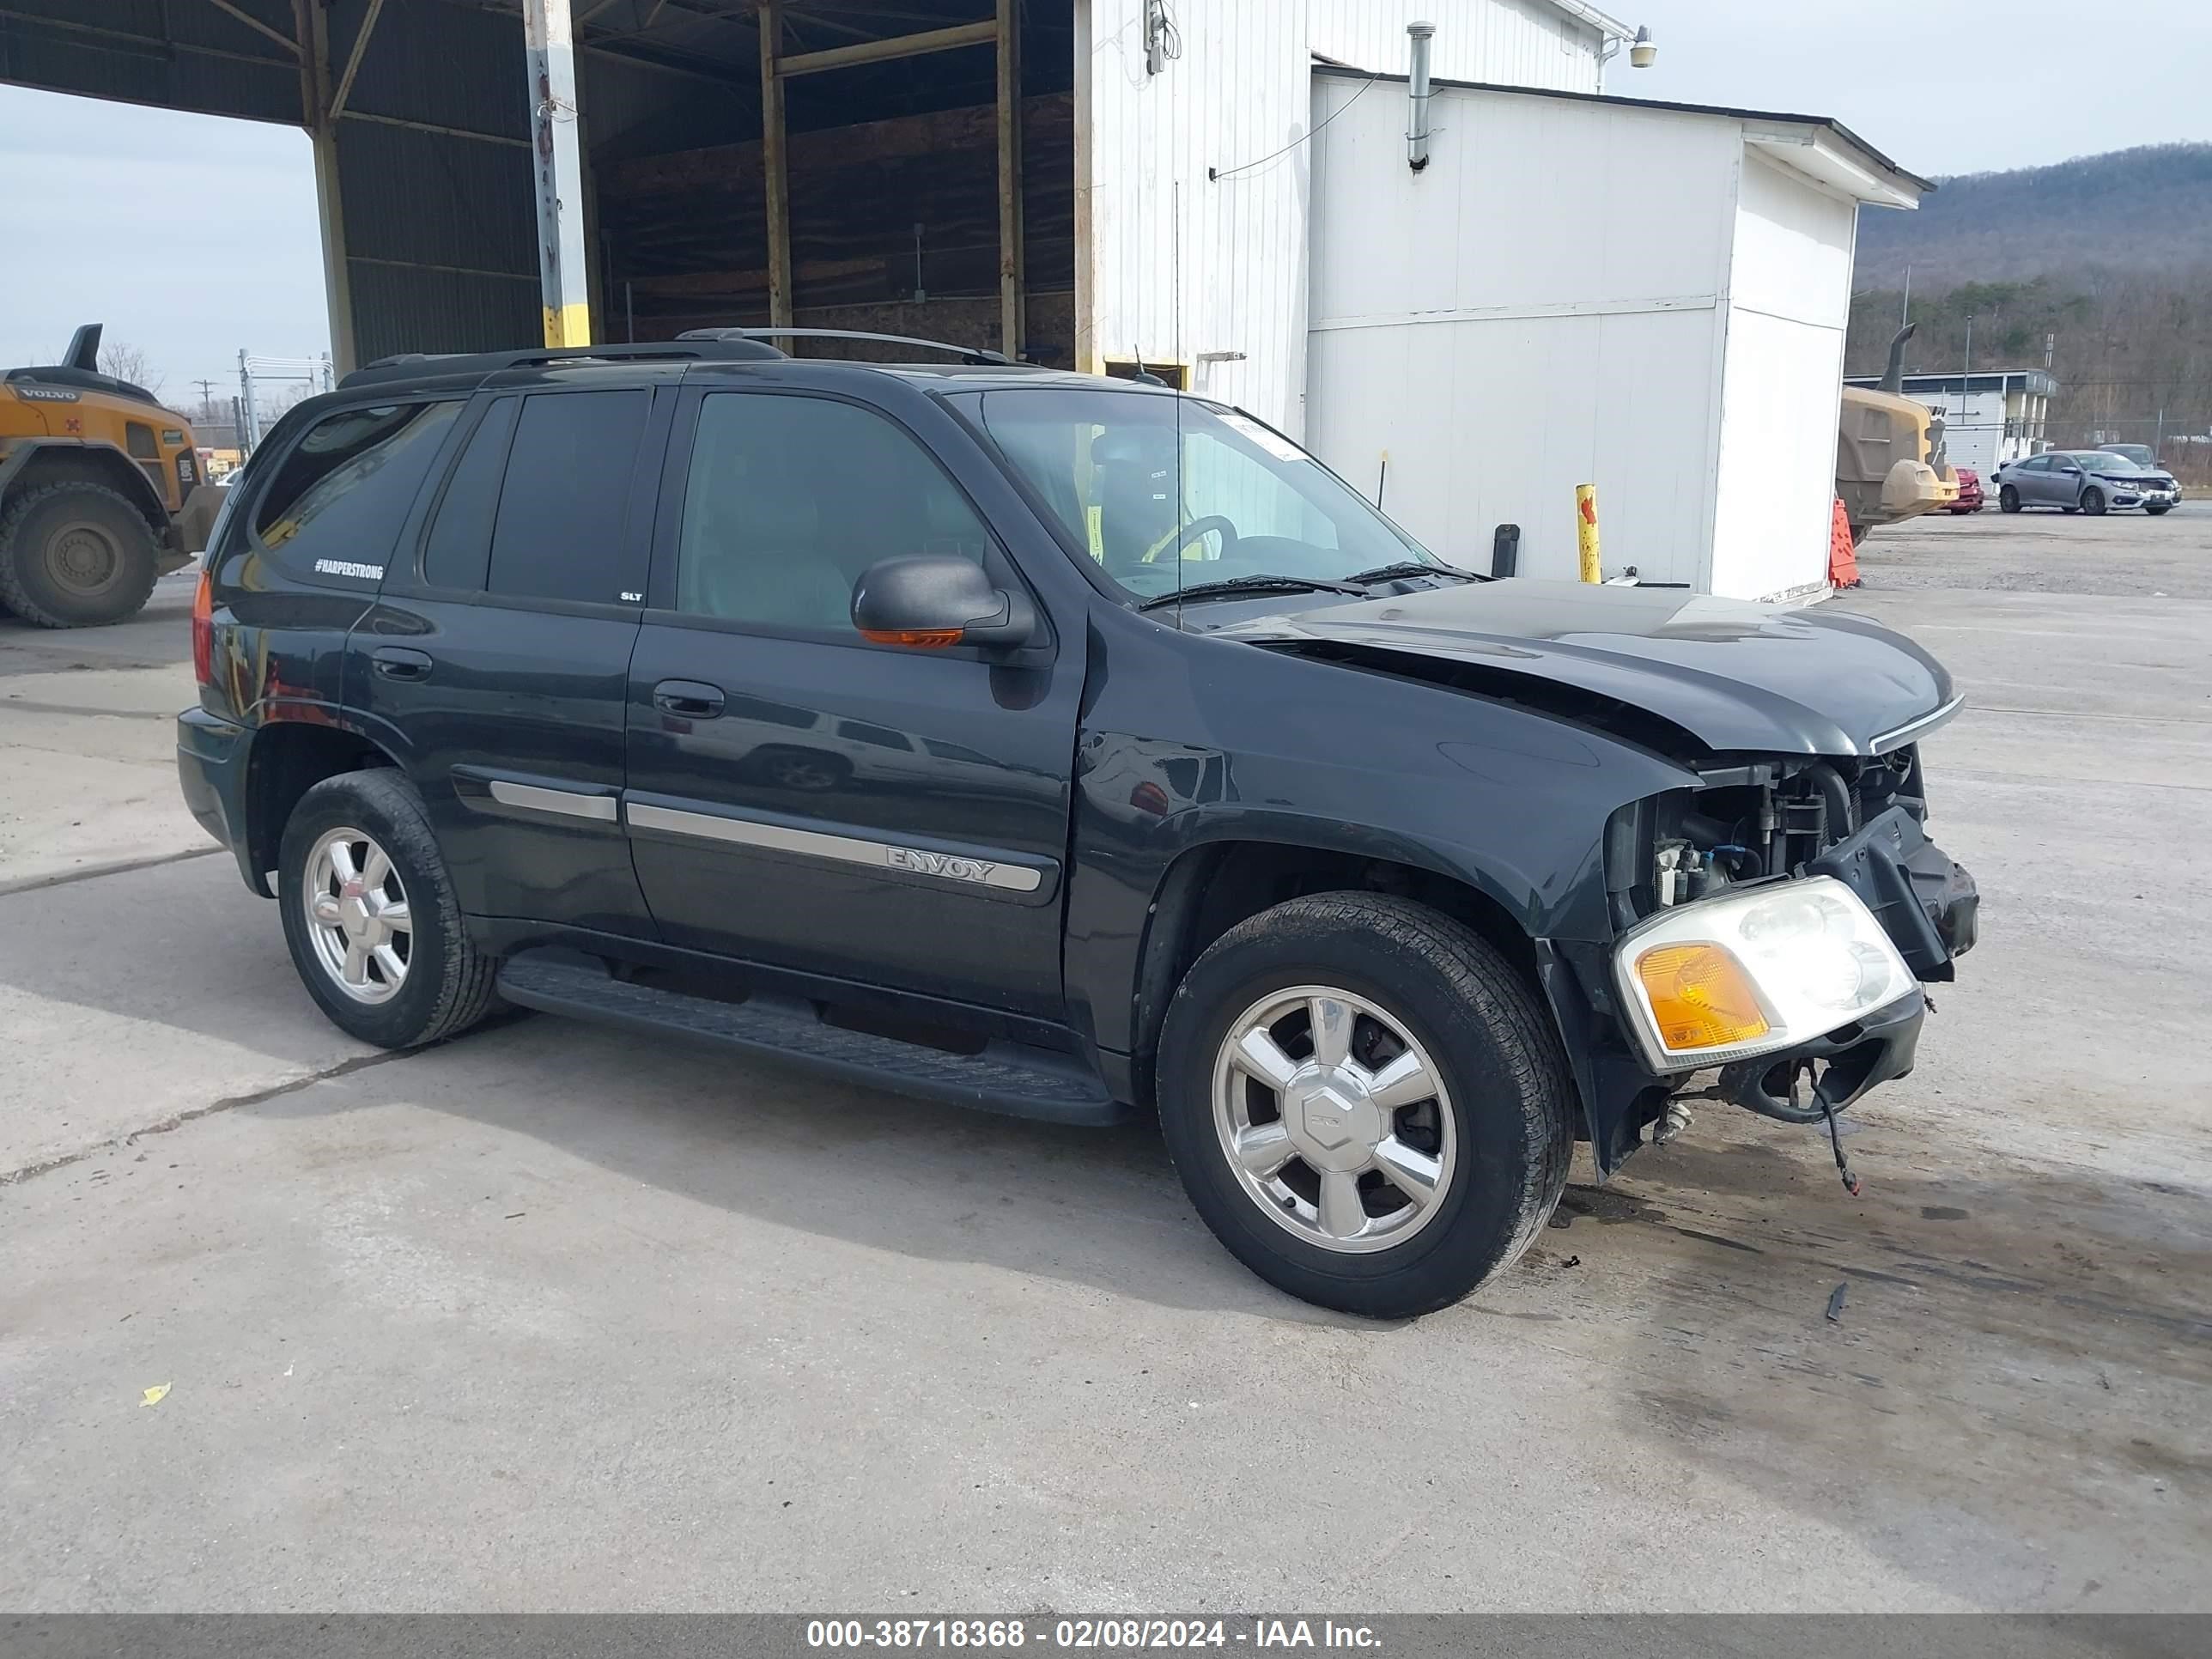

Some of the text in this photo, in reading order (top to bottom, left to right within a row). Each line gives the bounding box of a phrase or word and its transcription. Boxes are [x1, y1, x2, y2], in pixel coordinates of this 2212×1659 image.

[21, 389, 76, 399] VOLVO
[315, 558, 384, 580] #HARPERSTRONG
[621, 592, 643, 602] SLT
[886, 847, 996, 881] ENVOY
